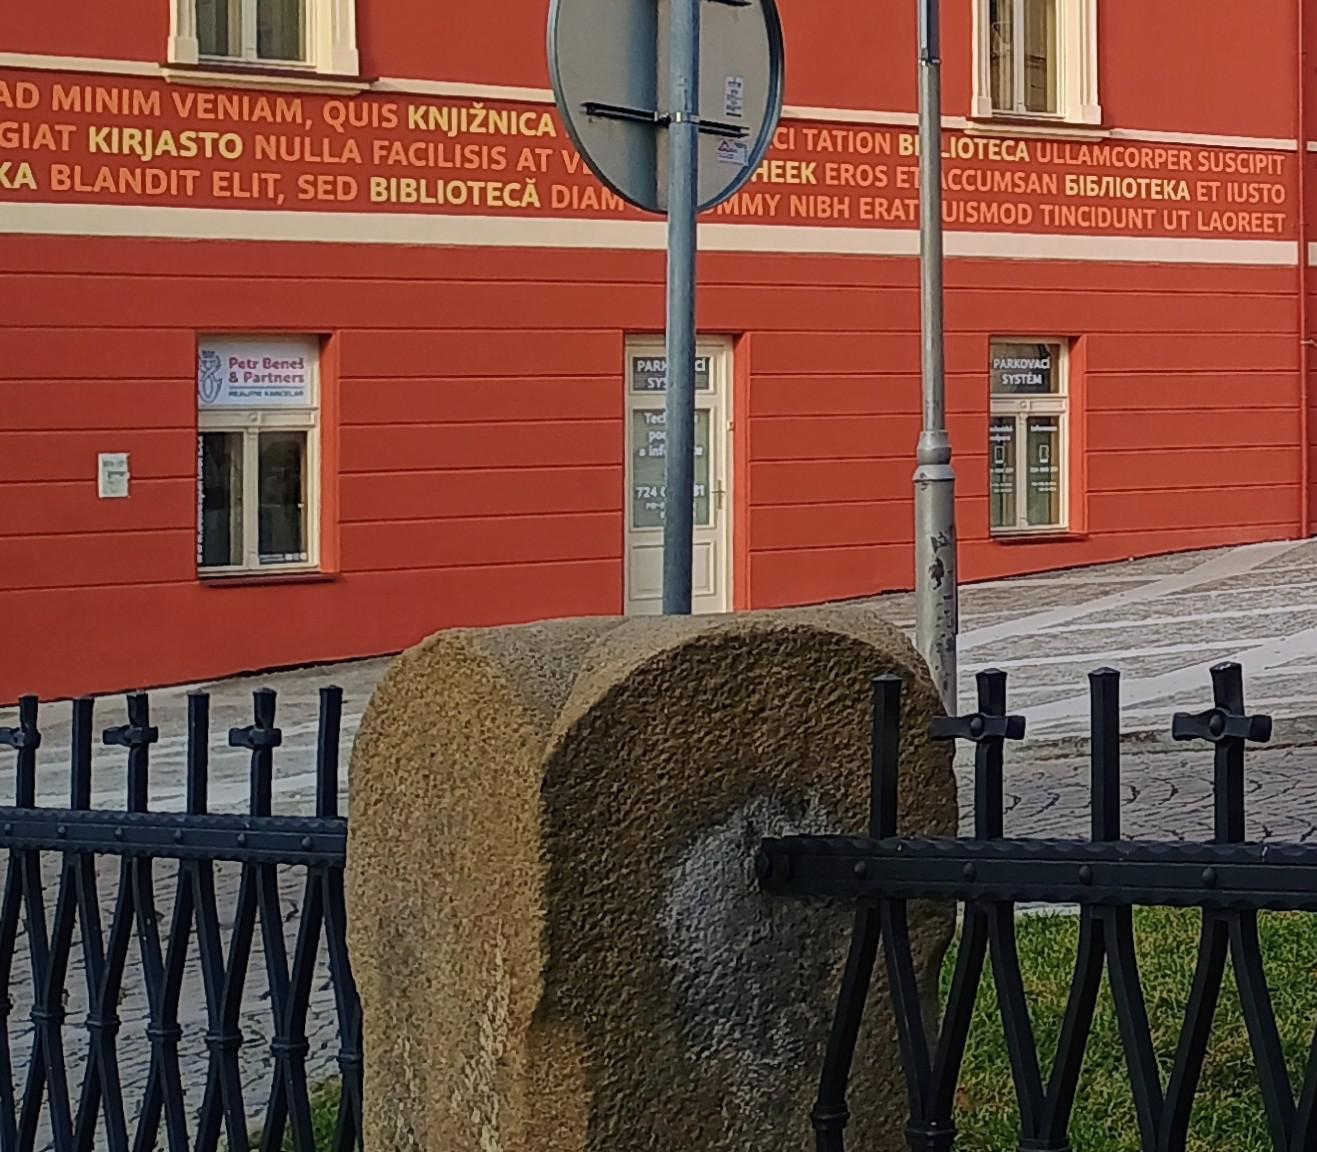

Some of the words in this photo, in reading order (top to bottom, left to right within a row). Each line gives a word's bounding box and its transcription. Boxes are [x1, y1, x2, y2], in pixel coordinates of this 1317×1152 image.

[0, 80, 39, 109] AD
[52, 84, 160, 116] MINIM
[172, 93, 313, 130] VENIAM,
[323, 100, 398, 133] QUIS
[408, 102, 557, 138] KNJIŽNICA
[89, 126, 243, 161] KIRJASTO
[255, 135, 362, 164] NULLA
[373, 141, 507, 171] FACILISIS
[516, 147, 554, 173] AT
[769, 127, 795, 150] CI
[803, 129, 891, 155] TATION
[1036, 143, 1193, 171] ULLAMCORPER
[1197, 151, 1285, 175] SUSCIPIT
[751, 159, 817, 185] HEEK
[825, 163, 888, 187] EROS
[51, 164, 200, 196] BLANDIT
[212, 171, 285, 205] ELIT,
[298, 175, 358, 201] SED
[370, 176, 540, 207] BIBLIOTECĂ
[551, 184, 625, 211] DIAM
[1065, 175, 1190, 201] БІБЛІОТЕКА
[1197, 180, 1222, 202] ET
[1228, 183, 1285, 204] IUSTO
[714, 192, 781, 217] MMY
[790, 195, 850, 219] NIBH
[859, 198, 919, 221] ERAT
[942, 200, 1033, 225] UISMOD
[1040, 204, 1157, 229] TINCIDUNT
[1163, 209, 1190, 230] UT
[1197, 211, 1285, 233] LAOREET
[229, 357, 258, 369] Petr
[244, 372, 304, 383] Partners
[1002, 372, 1042, 385] SYSTÉM
